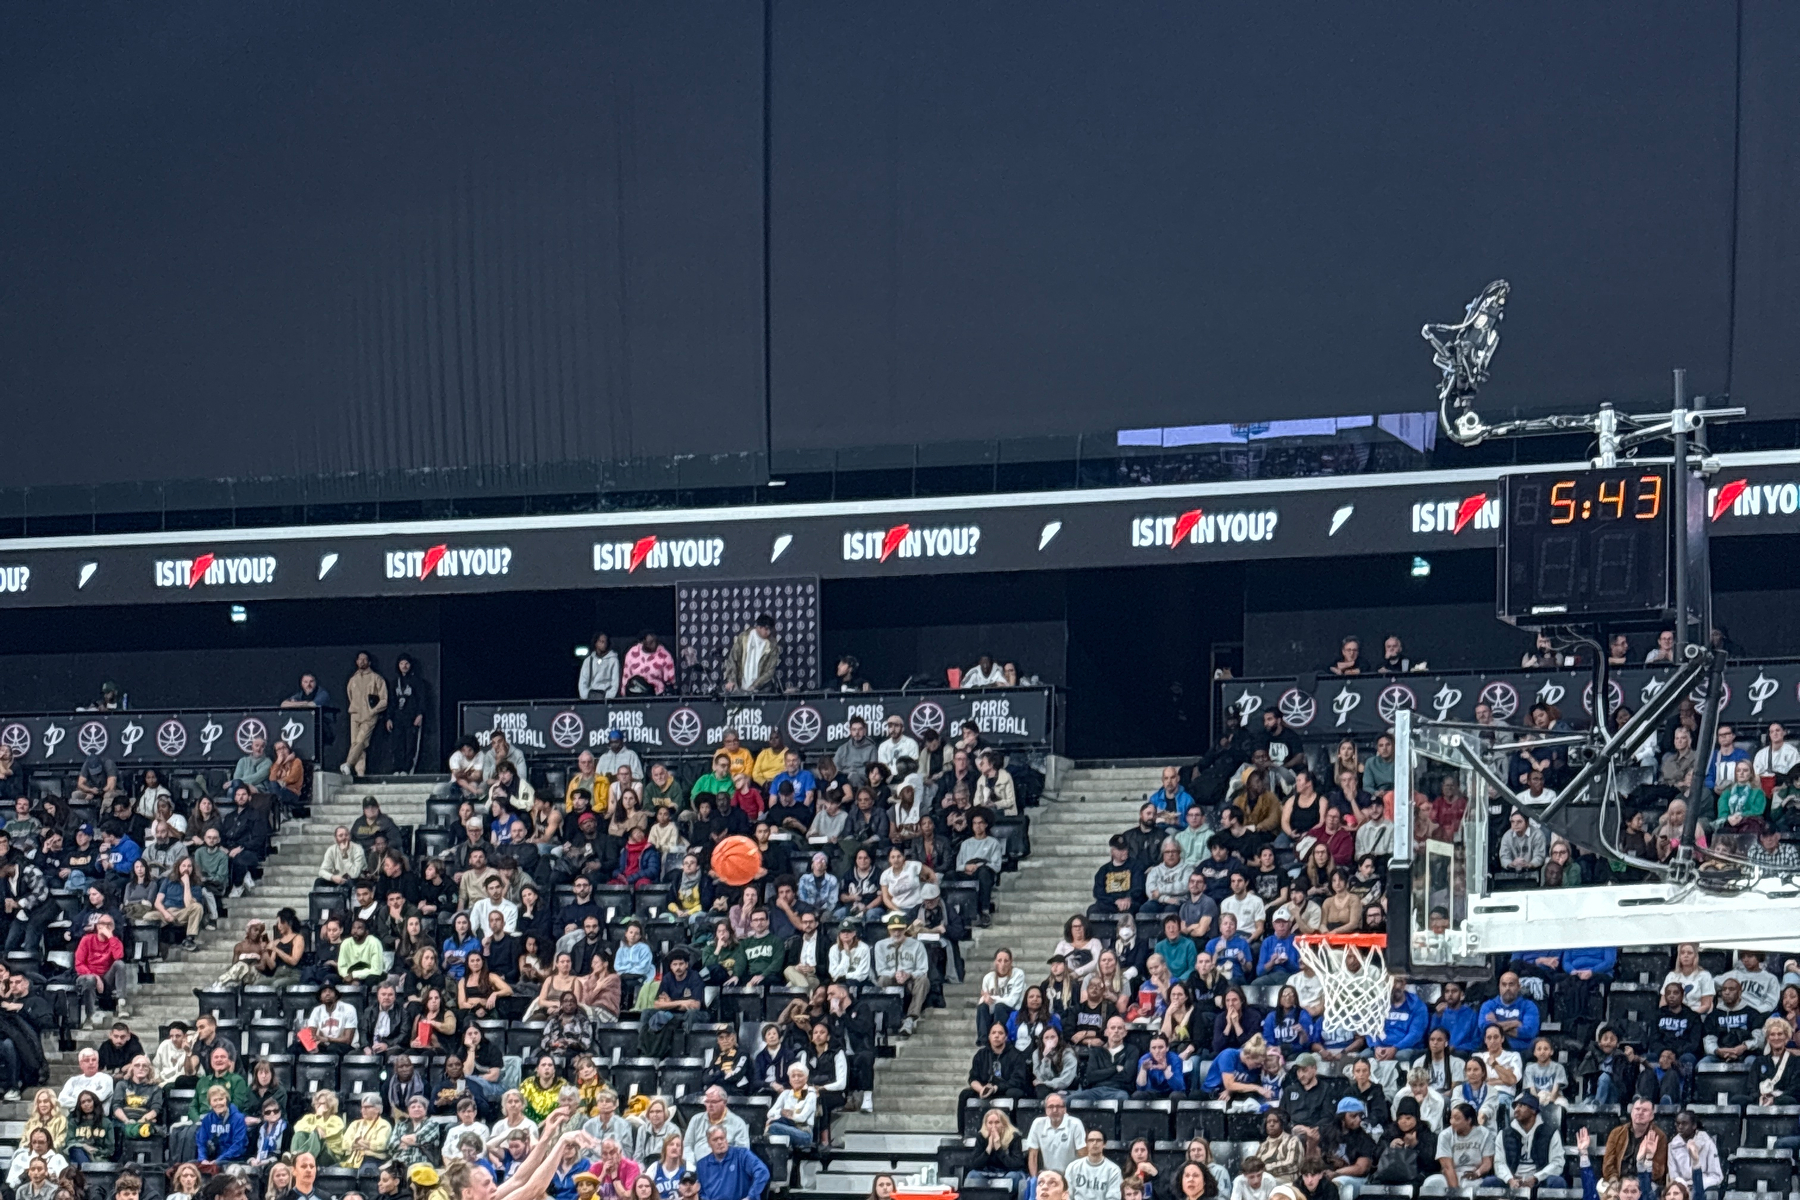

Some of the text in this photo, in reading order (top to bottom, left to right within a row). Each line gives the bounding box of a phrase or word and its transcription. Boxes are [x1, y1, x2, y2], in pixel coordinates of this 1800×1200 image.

[1550, 475, 1662, 525] 5:43
[1763, 483, 1800, 515] YO
[1217, 511, 1277, 543] YOU?
[669, 537, 724, 568] YOU?
[923, 526, 981, 557] YOU?
[226, 556, 277, 584] YOU?
[459, 547, 511, 576] YOU?
[0, 566, 30, 593] OU?
[608, 710, 644, 728] PARIS
[847, 704, 884, 723] PARIS
[971, 699, 1010, 718] PARIS
[493, 712, 528, 729] PARIS
[827, 720, 890, 743] BASTBA
[950, 716, 1029, 738] BKETBALL
[475, 728, 546, 749] BAETBALL
[589, 726, 663, 748] BASTBALL
[706, 724, 772, 745] BAETBAL
[656, 1180, 681, 1194] DUK
